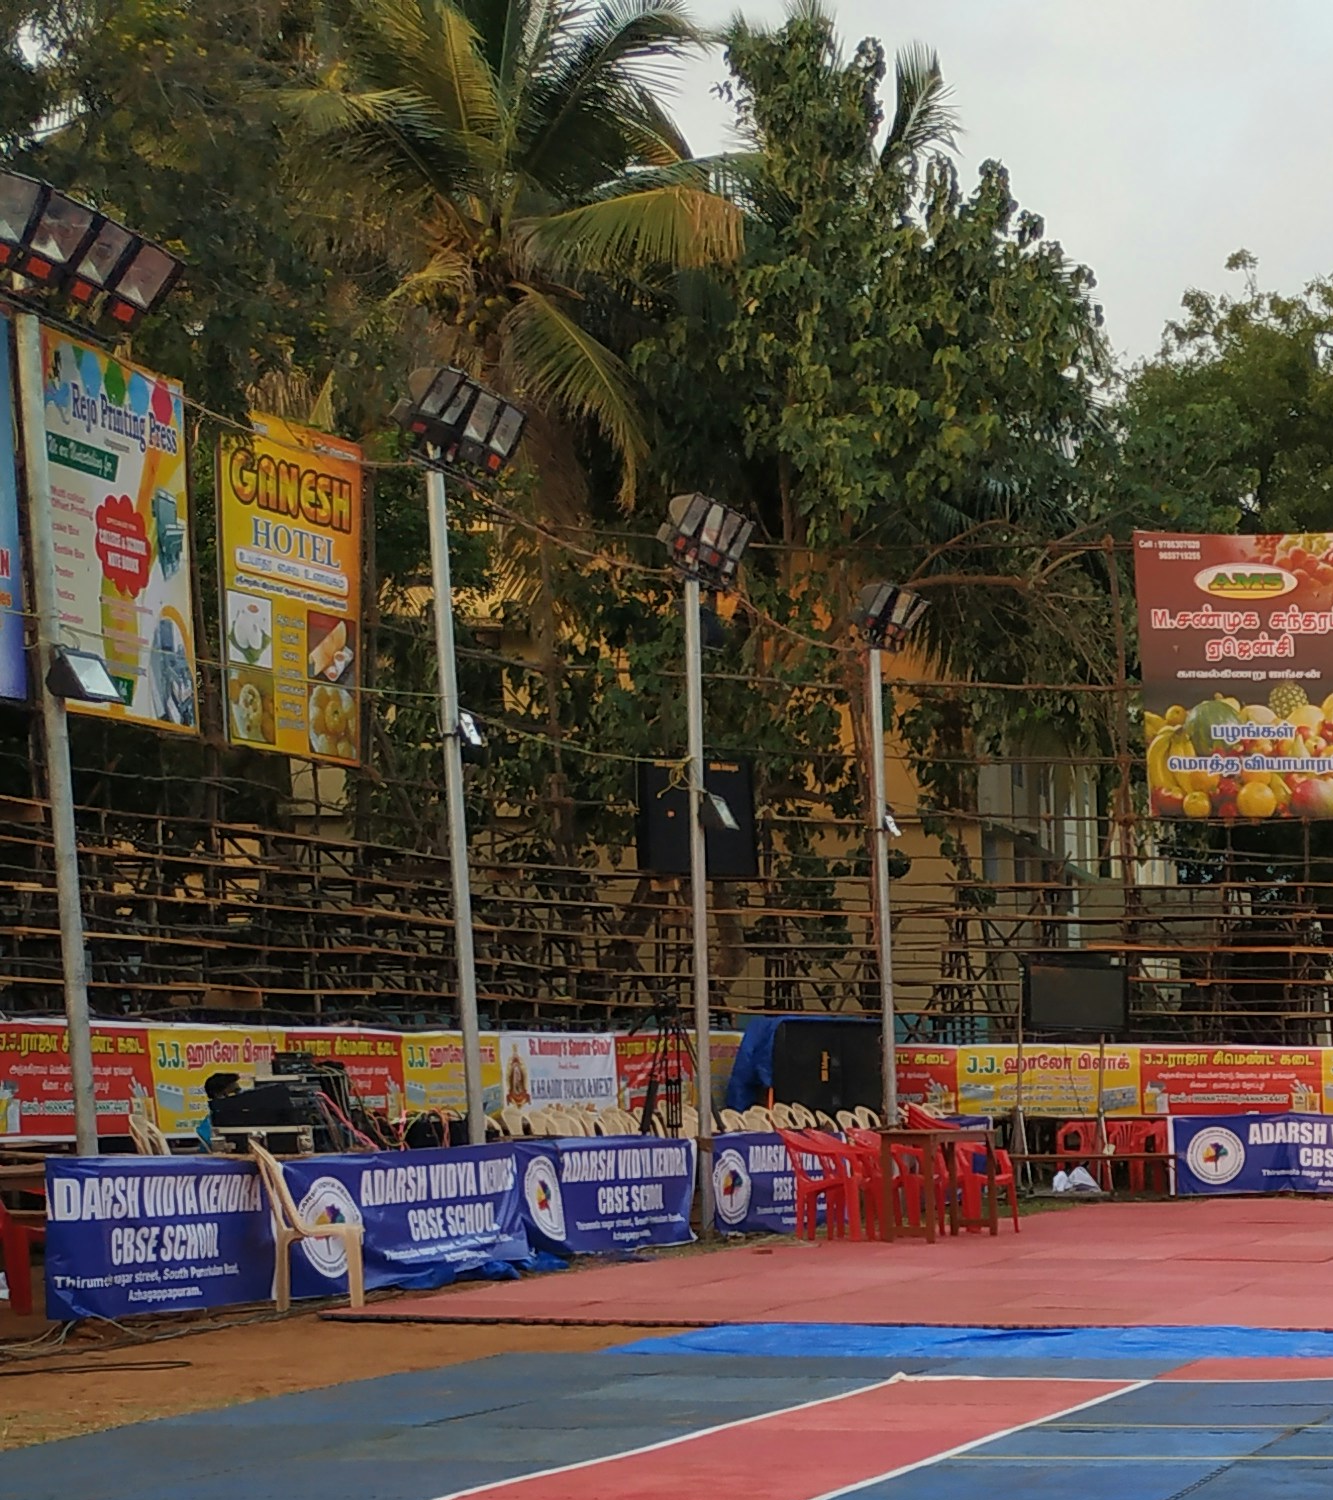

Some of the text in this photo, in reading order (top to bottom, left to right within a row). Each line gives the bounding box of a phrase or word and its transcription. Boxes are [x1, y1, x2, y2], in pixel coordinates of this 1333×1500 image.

[71, 382, 177, 453] Rejo Printing Press
[230, 448, 352, 535] GANESH
[252, 517, 341, 569] HOTEL
[1208, 572, 1285, 591] AMS
[1152, 604, 1260, 632] M.சண்முக
[1206, 632, 1294, 661] ஏஜென்சி
[1212, 721, 1295, 744] பழங்கள்
[1169, 753, 1239, 774] மொத்த
[1077, 1052, 1130, 1072] பிளாக்
[1213, 1050, 1315, 1066] சிமெண்ட் கடை
[1249, 1123, 1325, 1145] ADARSH
[562, 1147, 687, 1183] ADARSH KENDRA
[749, 1145, 786, 1173] ADARSH
[143, 1174, 263, 1217] VIDYA KENDRA
[361, 1161, 477, 1207] ADARSH VIDYA
[598, 1186, 630, 1215] CBSE
[408, 1206, 444, 1242] CBSE
[111, 1226, 160, 1266] CBSE
[163, 1268, 189, 1281] South
